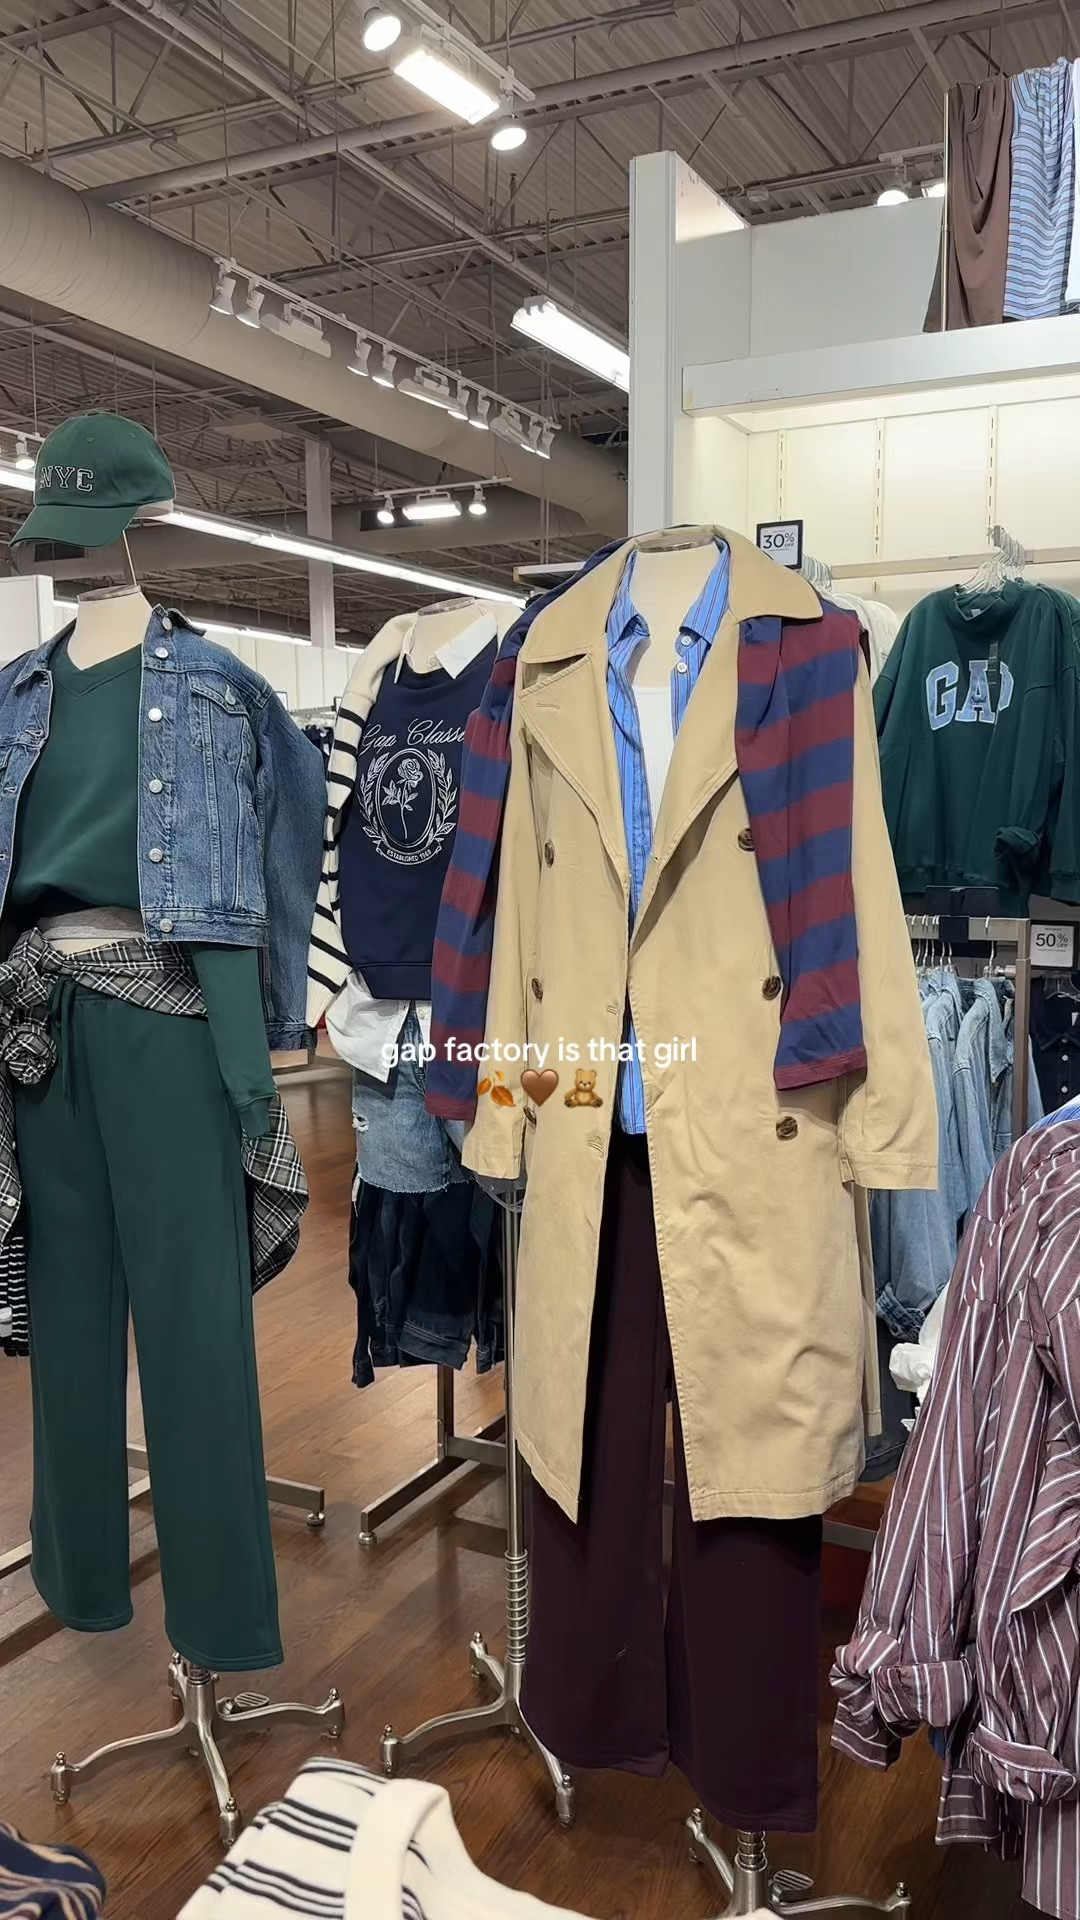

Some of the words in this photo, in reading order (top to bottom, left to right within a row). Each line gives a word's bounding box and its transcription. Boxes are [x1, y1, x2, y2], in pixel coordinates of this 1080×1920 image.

[40, 465, 94, 491] NYC
[763, 532, 795, 549] 30%
[359, 723, 397, 754] Gap
[407, 718, 465, 746] Classi
[1036, 933, 1068, 947] 50%
